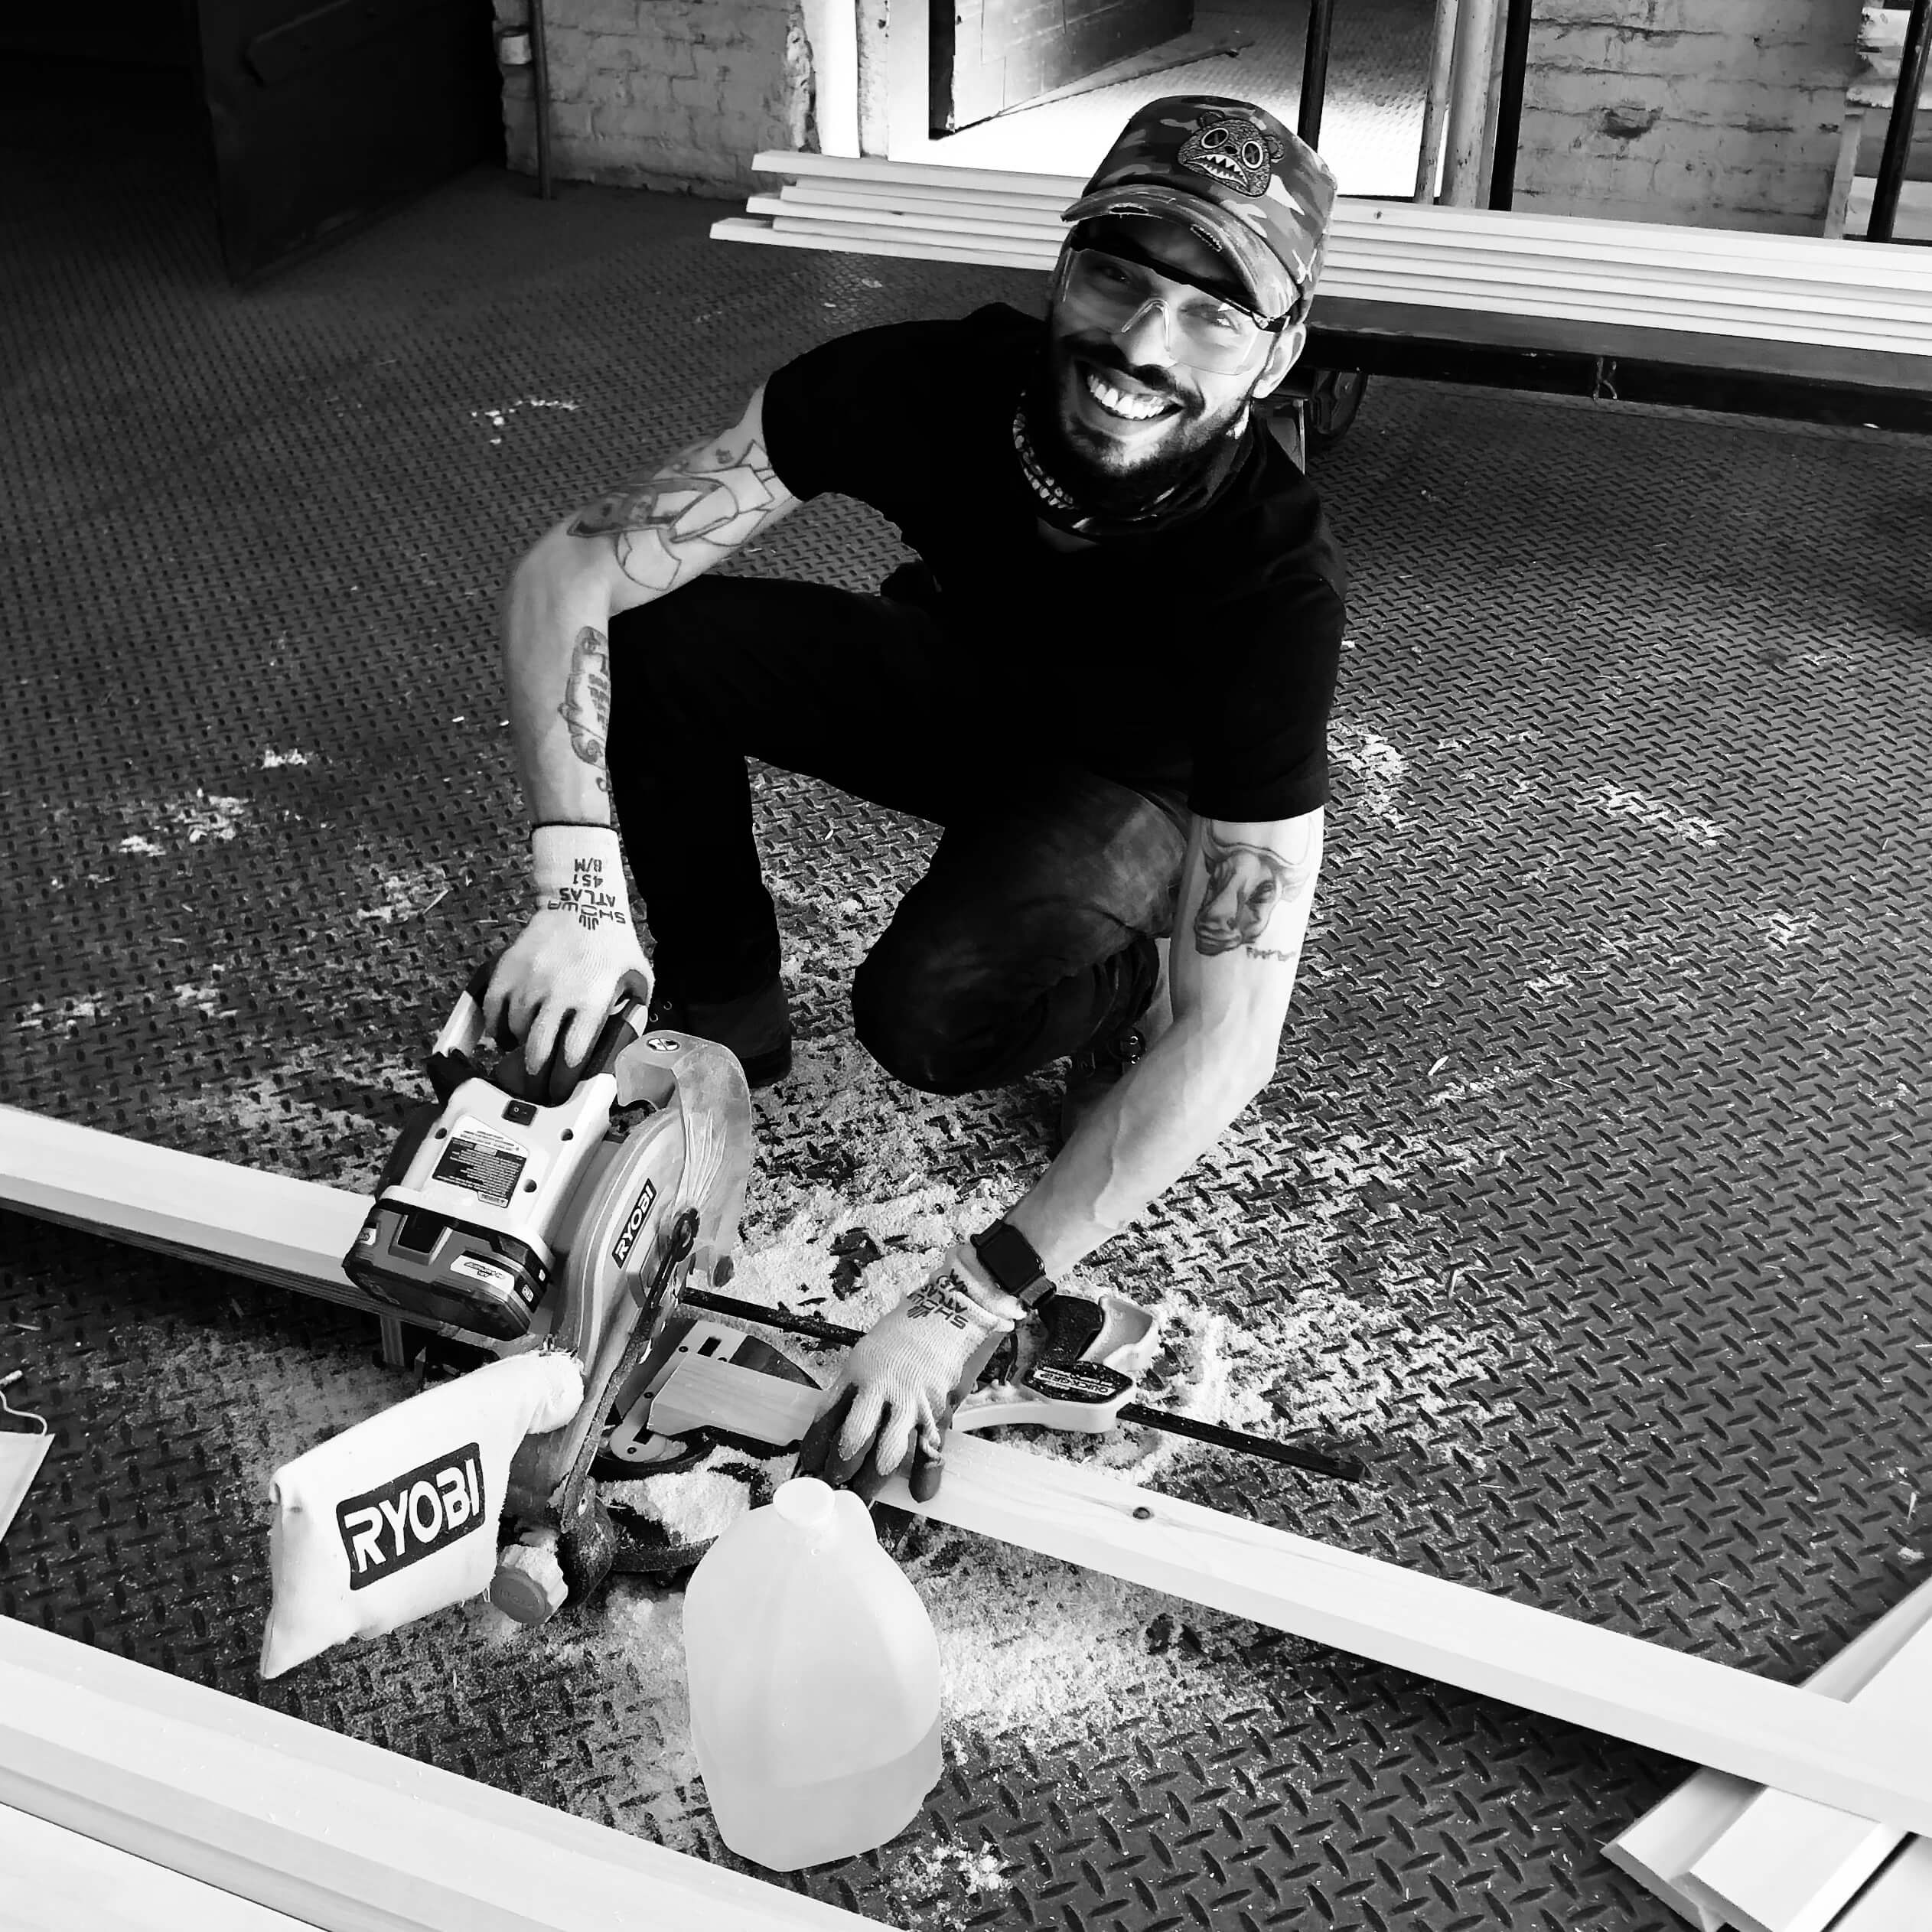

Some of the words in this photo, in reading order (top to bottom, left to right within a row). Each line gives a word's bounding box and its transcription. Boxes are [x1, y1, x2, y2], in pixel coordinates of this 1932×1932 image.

[573, 874, 603, 888] 451
[559, 888, 616, 907] ATLAS
[547, 900, 626, 924] SHOWA
[614, 1185, 653, 1260] RYOBI
[344, 1458, 481, 1573] RYOBI
